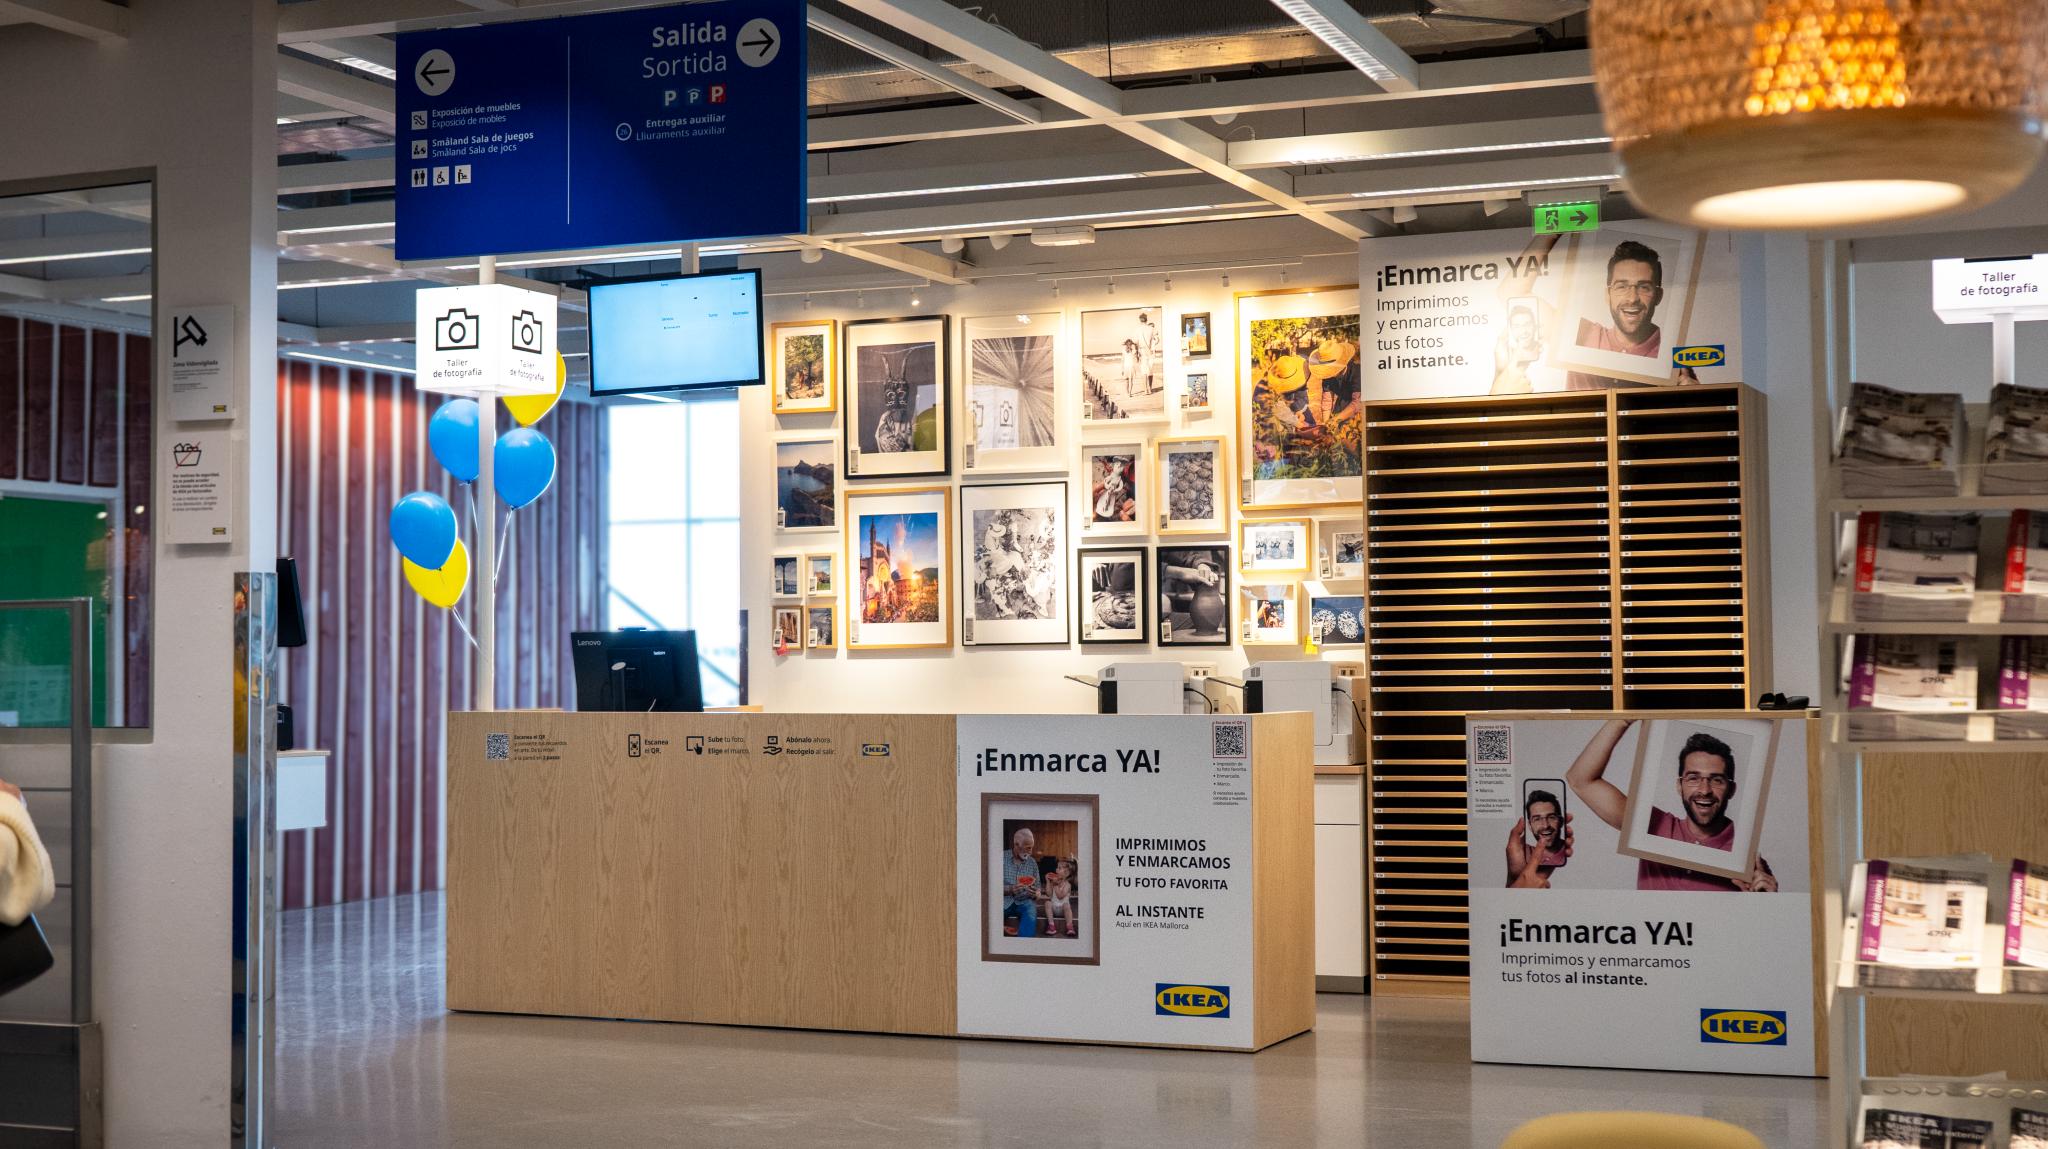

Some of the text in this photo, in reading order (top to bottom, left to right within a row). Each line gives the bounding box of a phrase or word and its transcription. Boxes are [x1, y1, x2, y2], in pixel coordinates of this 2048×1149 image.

[652, 21, 727, 48] Salida
[642, 50, 727, 78] Sortida
[432, 102, 521, 118] Exposición de muebles
[432, 114, 507, 128] Exposició de mobles
[646, 113, 726, 129] Entregas auxiliar
[471, 134, 489, 144] Sala
[491, 133, 502, 142] de
[504, 131, 534, 143] juegos
[636, 128, 690, 141] Lliuraments
[692, 125, 726, 136] auxiliar
[469, 145, 486, 155] Sala
[488, 144, 498, 153] de
[500, 143, 517, 154] jocs
[1376, 255, 1549, 292] ¡Enmarca YA!
[1982, 272, 2016, 282] Taller
[1960, 283, 2038, 297] de fotografía
[1377, 294, 1470, 314] Imprimimos
[1377, 313, 1489, 334] y enmarcamos
[1377, 335, 1444, 351] tus fotos
[446, 359, 468, 367] Taller
[1378, 353, 1469, 371] al instante.
[433, 370, 442, 378] de
[708, 747, 723, 755] Elige
[786, 748, 815, 756] Recógelo
[976, 748, 1161, 777] ¡Enmarca YA!
[1116, 838, 1206, 852] IMPRIMIMOS
[1115, 855, 1231, 870] Y ENMARCAMOS
[1115, 876, 1229, 890] TU FOTO FAVORITA
[1115, 904, 1205, 919] AL INSTANTE
[1115, 920, 1131, 928] Aquí
[1143, 921, 1158, 929] IKEA
[1160, 922, 1189, 930] Mallorca
[1500, 918, 1694, 947] ¡Enmarca YA!
[1501, 952, 1691, 970] Imprimimos y enmarcamos
[1501, 970, 1648, 986] tus fotos al instante.
[1888, 1113, 1939, 1128] IKEA
